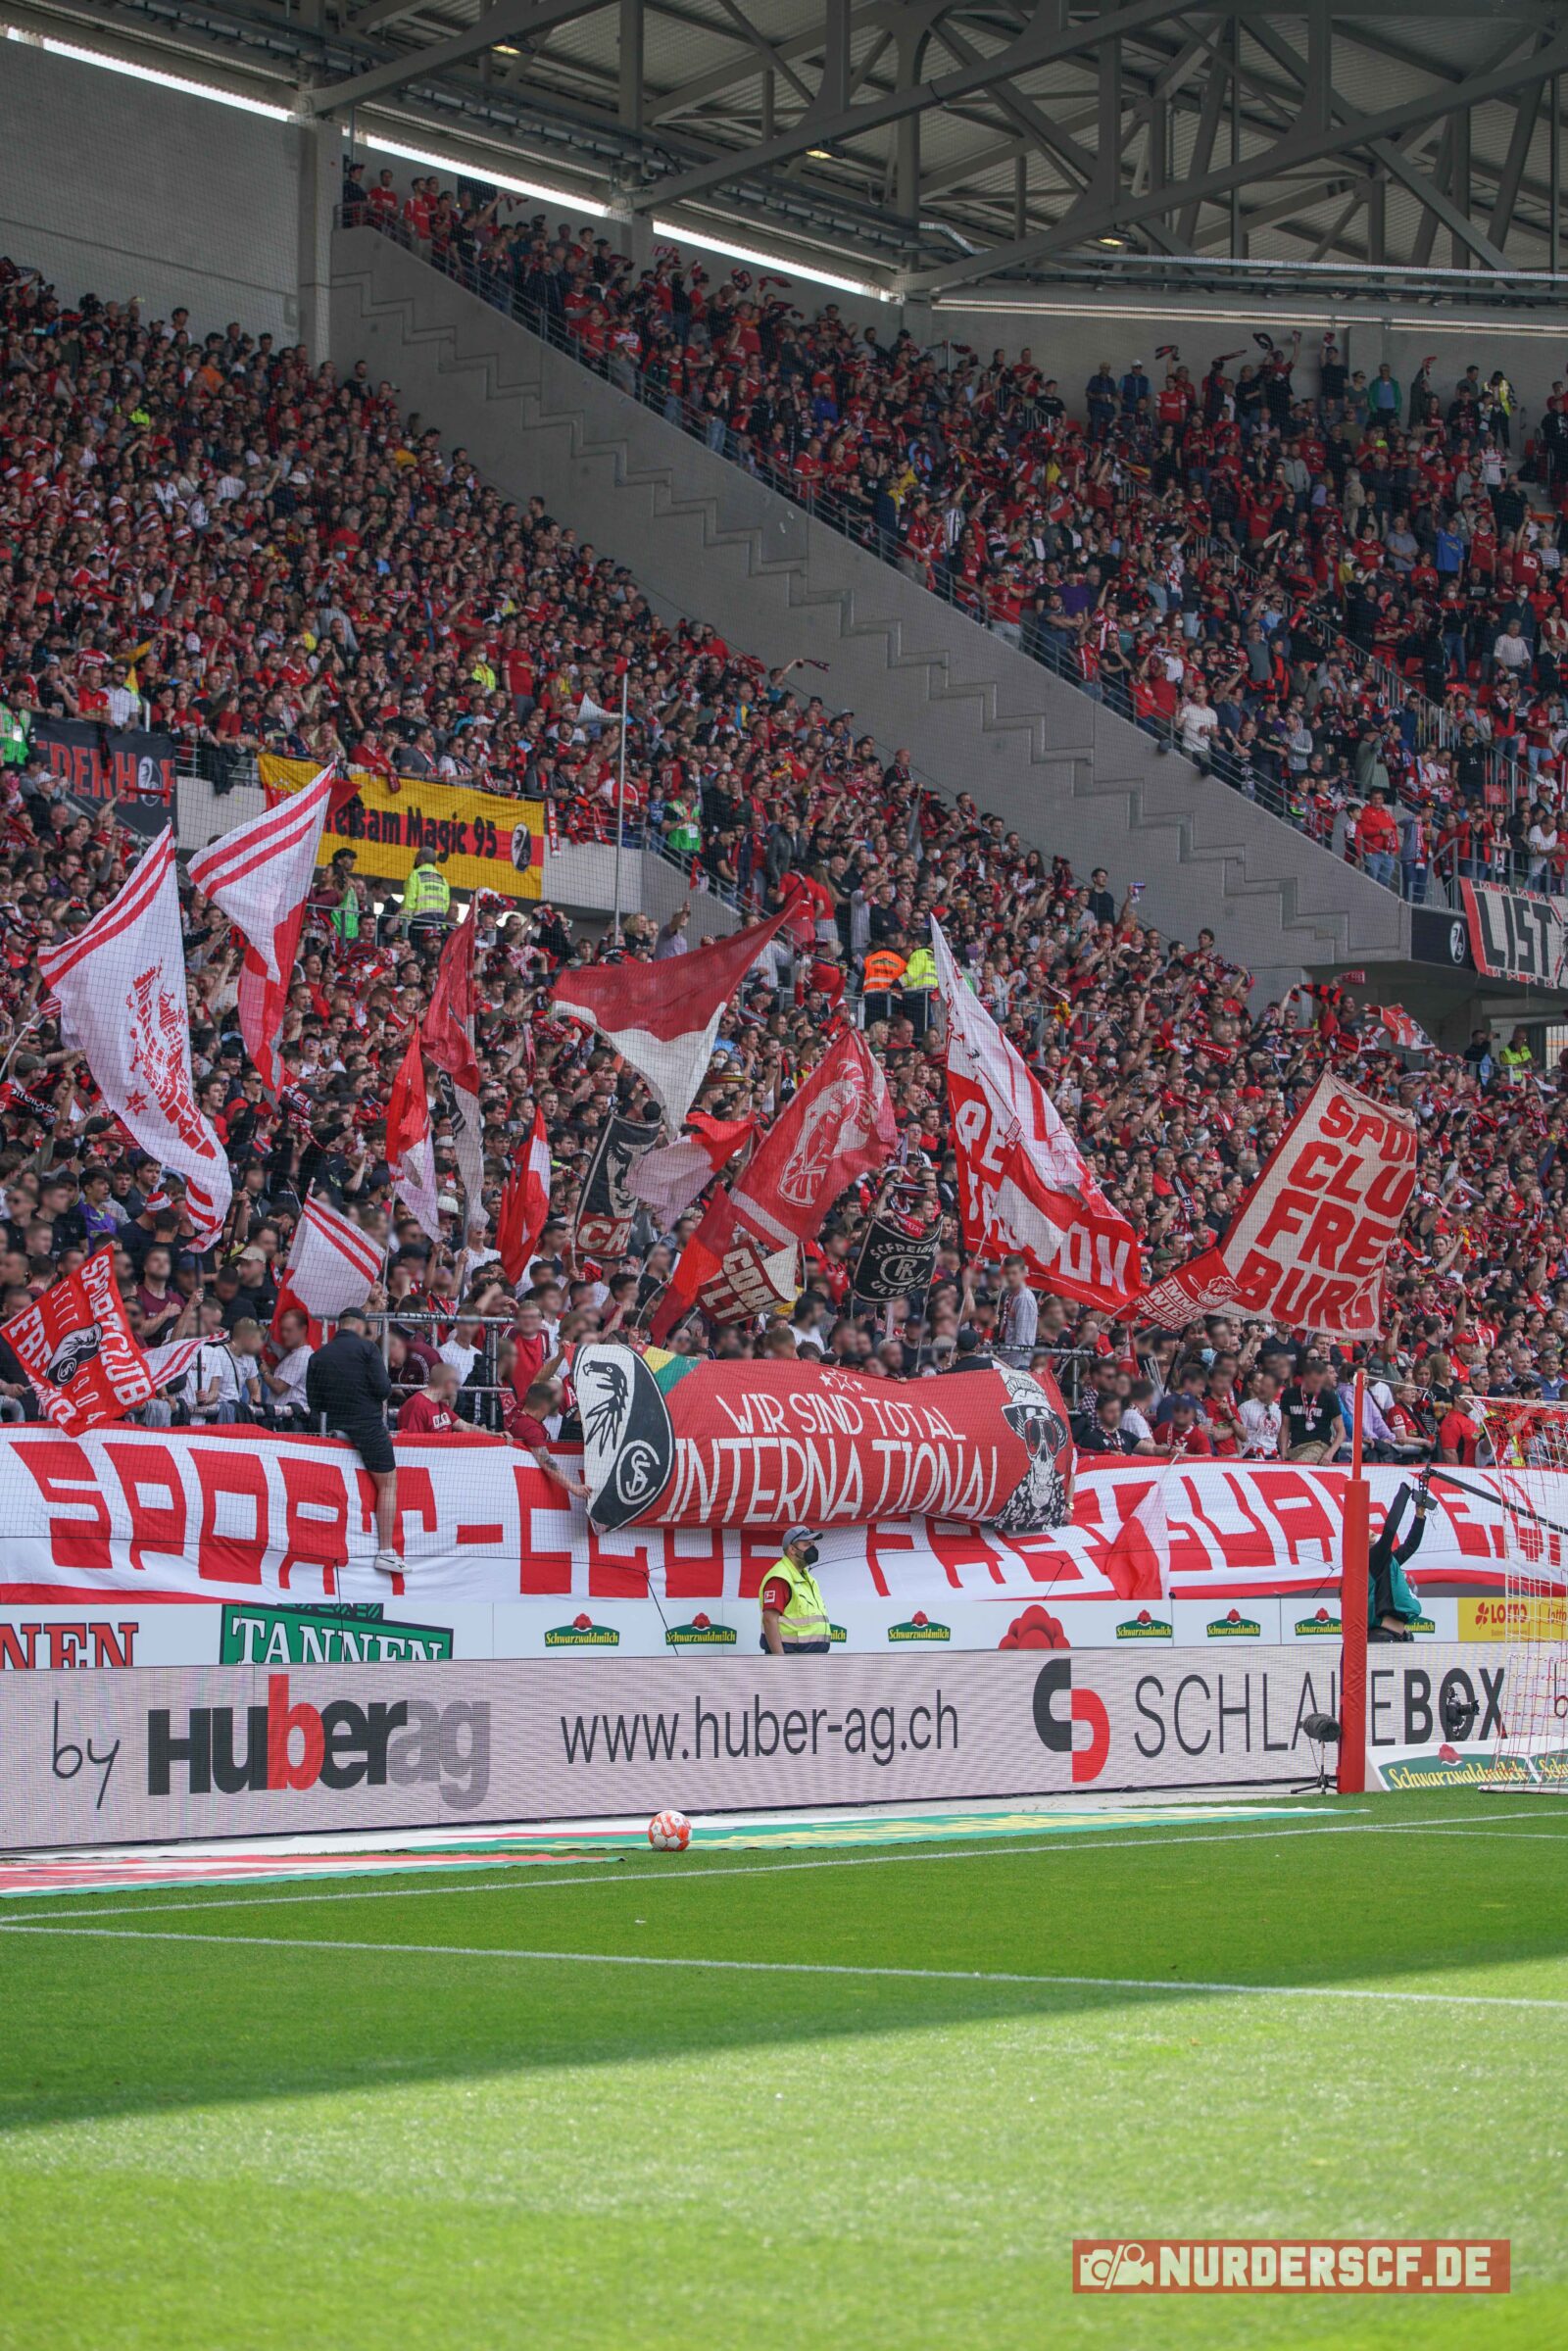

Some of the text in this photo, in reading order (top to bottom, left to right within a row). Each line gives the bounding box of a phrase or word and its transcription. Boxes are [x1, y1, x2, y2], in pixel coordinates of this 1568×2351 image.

[406, 807, 467, 862] Magic
[474, 816, 497, 858] 95
[1475, 891, 1553, 978] LIST
[1254, 1188, 1396, 1278] FRE
[1232, 1249, 1376, 1330] BURG
[715, 1392, 965, 1441] WIR SIND TOTAL
[546, 1632, 618, 1644] Schwarzwaldmilch
[666, 1631, 736, 1642] Schwarzwaldmilch
[889, 1629, 950, 1641] Schwarzwaldmilch
[1116, 1626, 1171, 1638] Schwarzwaldmilch
[1207, 1624, 1259, 1636] Schwarzwaldmilch
[1491, 1603, 1527, 1624] LOTTO
[560, 1689, 958, 1766] www.huber-ag.ch
[1134, 1667, 1506, 1758] SCHLAEBOX
[53, 1699, 121, 1810] by
[1389, 1760, 1529, 1789] Schwarzwaldmilch
